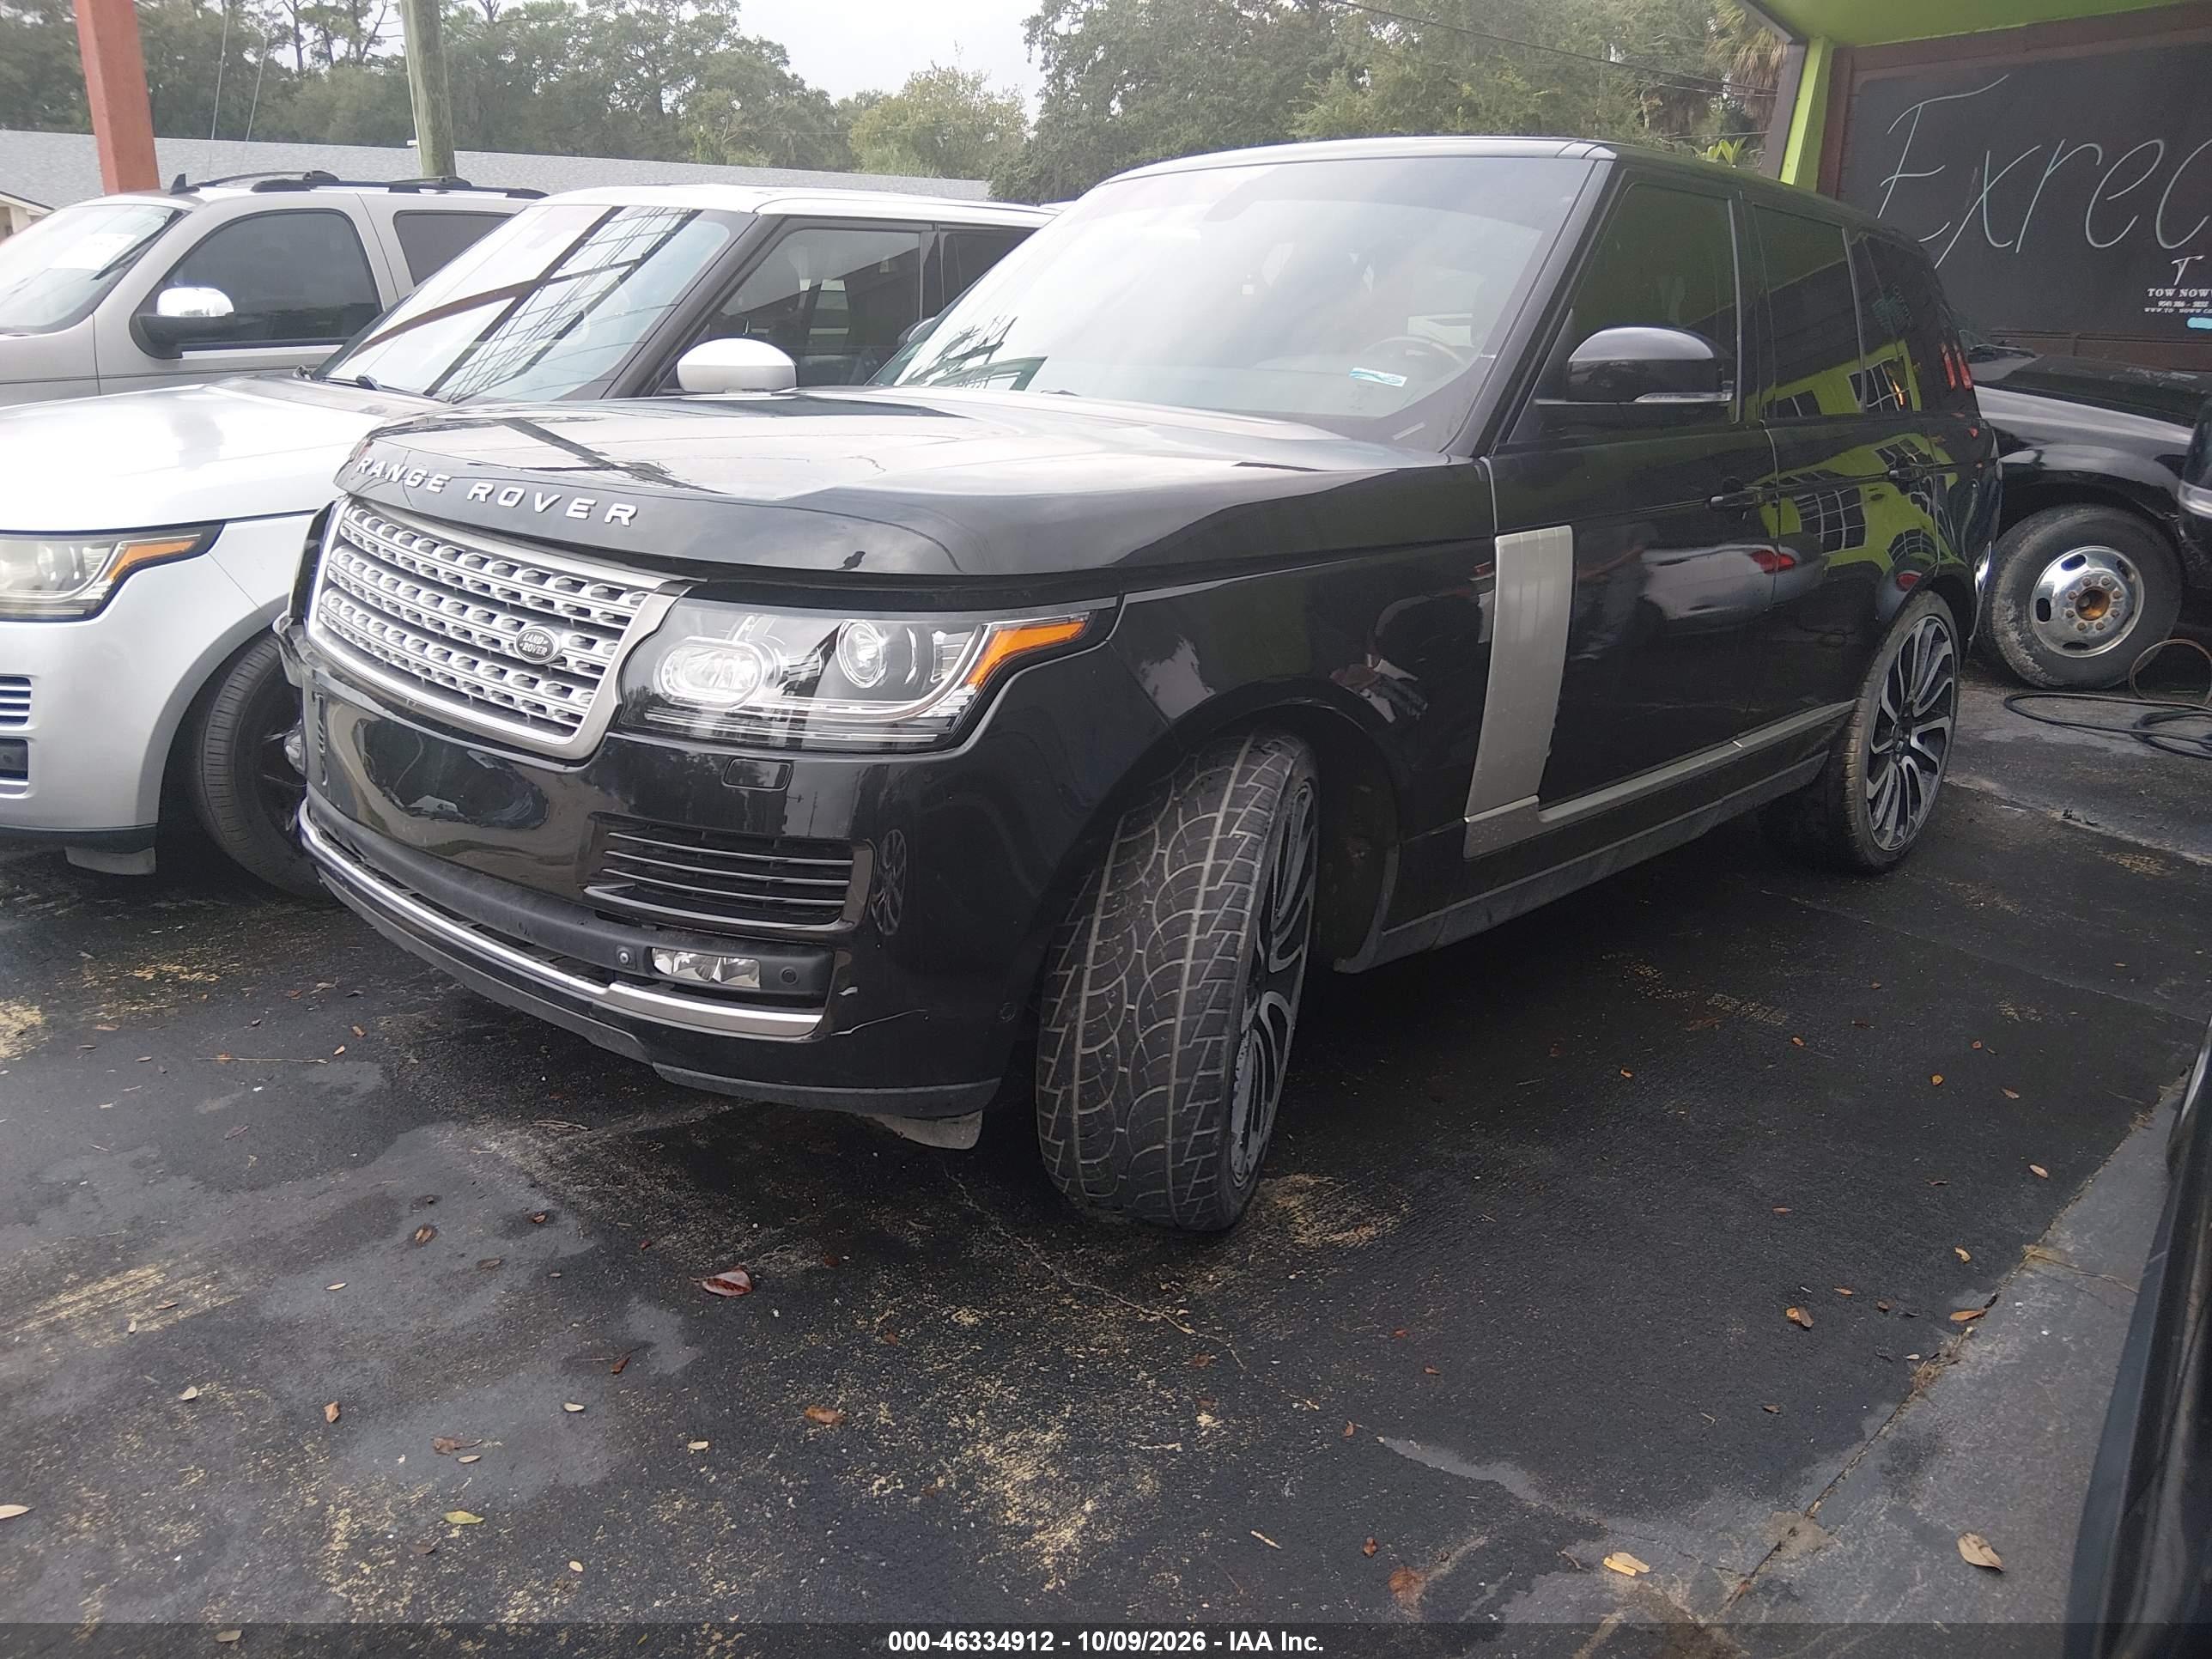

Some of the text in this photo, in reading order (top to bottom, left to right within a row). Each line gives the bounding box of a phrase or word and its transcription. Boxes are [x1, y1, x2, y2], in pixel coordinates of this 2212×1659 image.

[2147, 288, 2212, 297] TOW NOW
[357, 458, 637, 526] RANGE ROVER
[522, 633, 545, 645] LAND
[522, 642, 548, 657] ROVER
